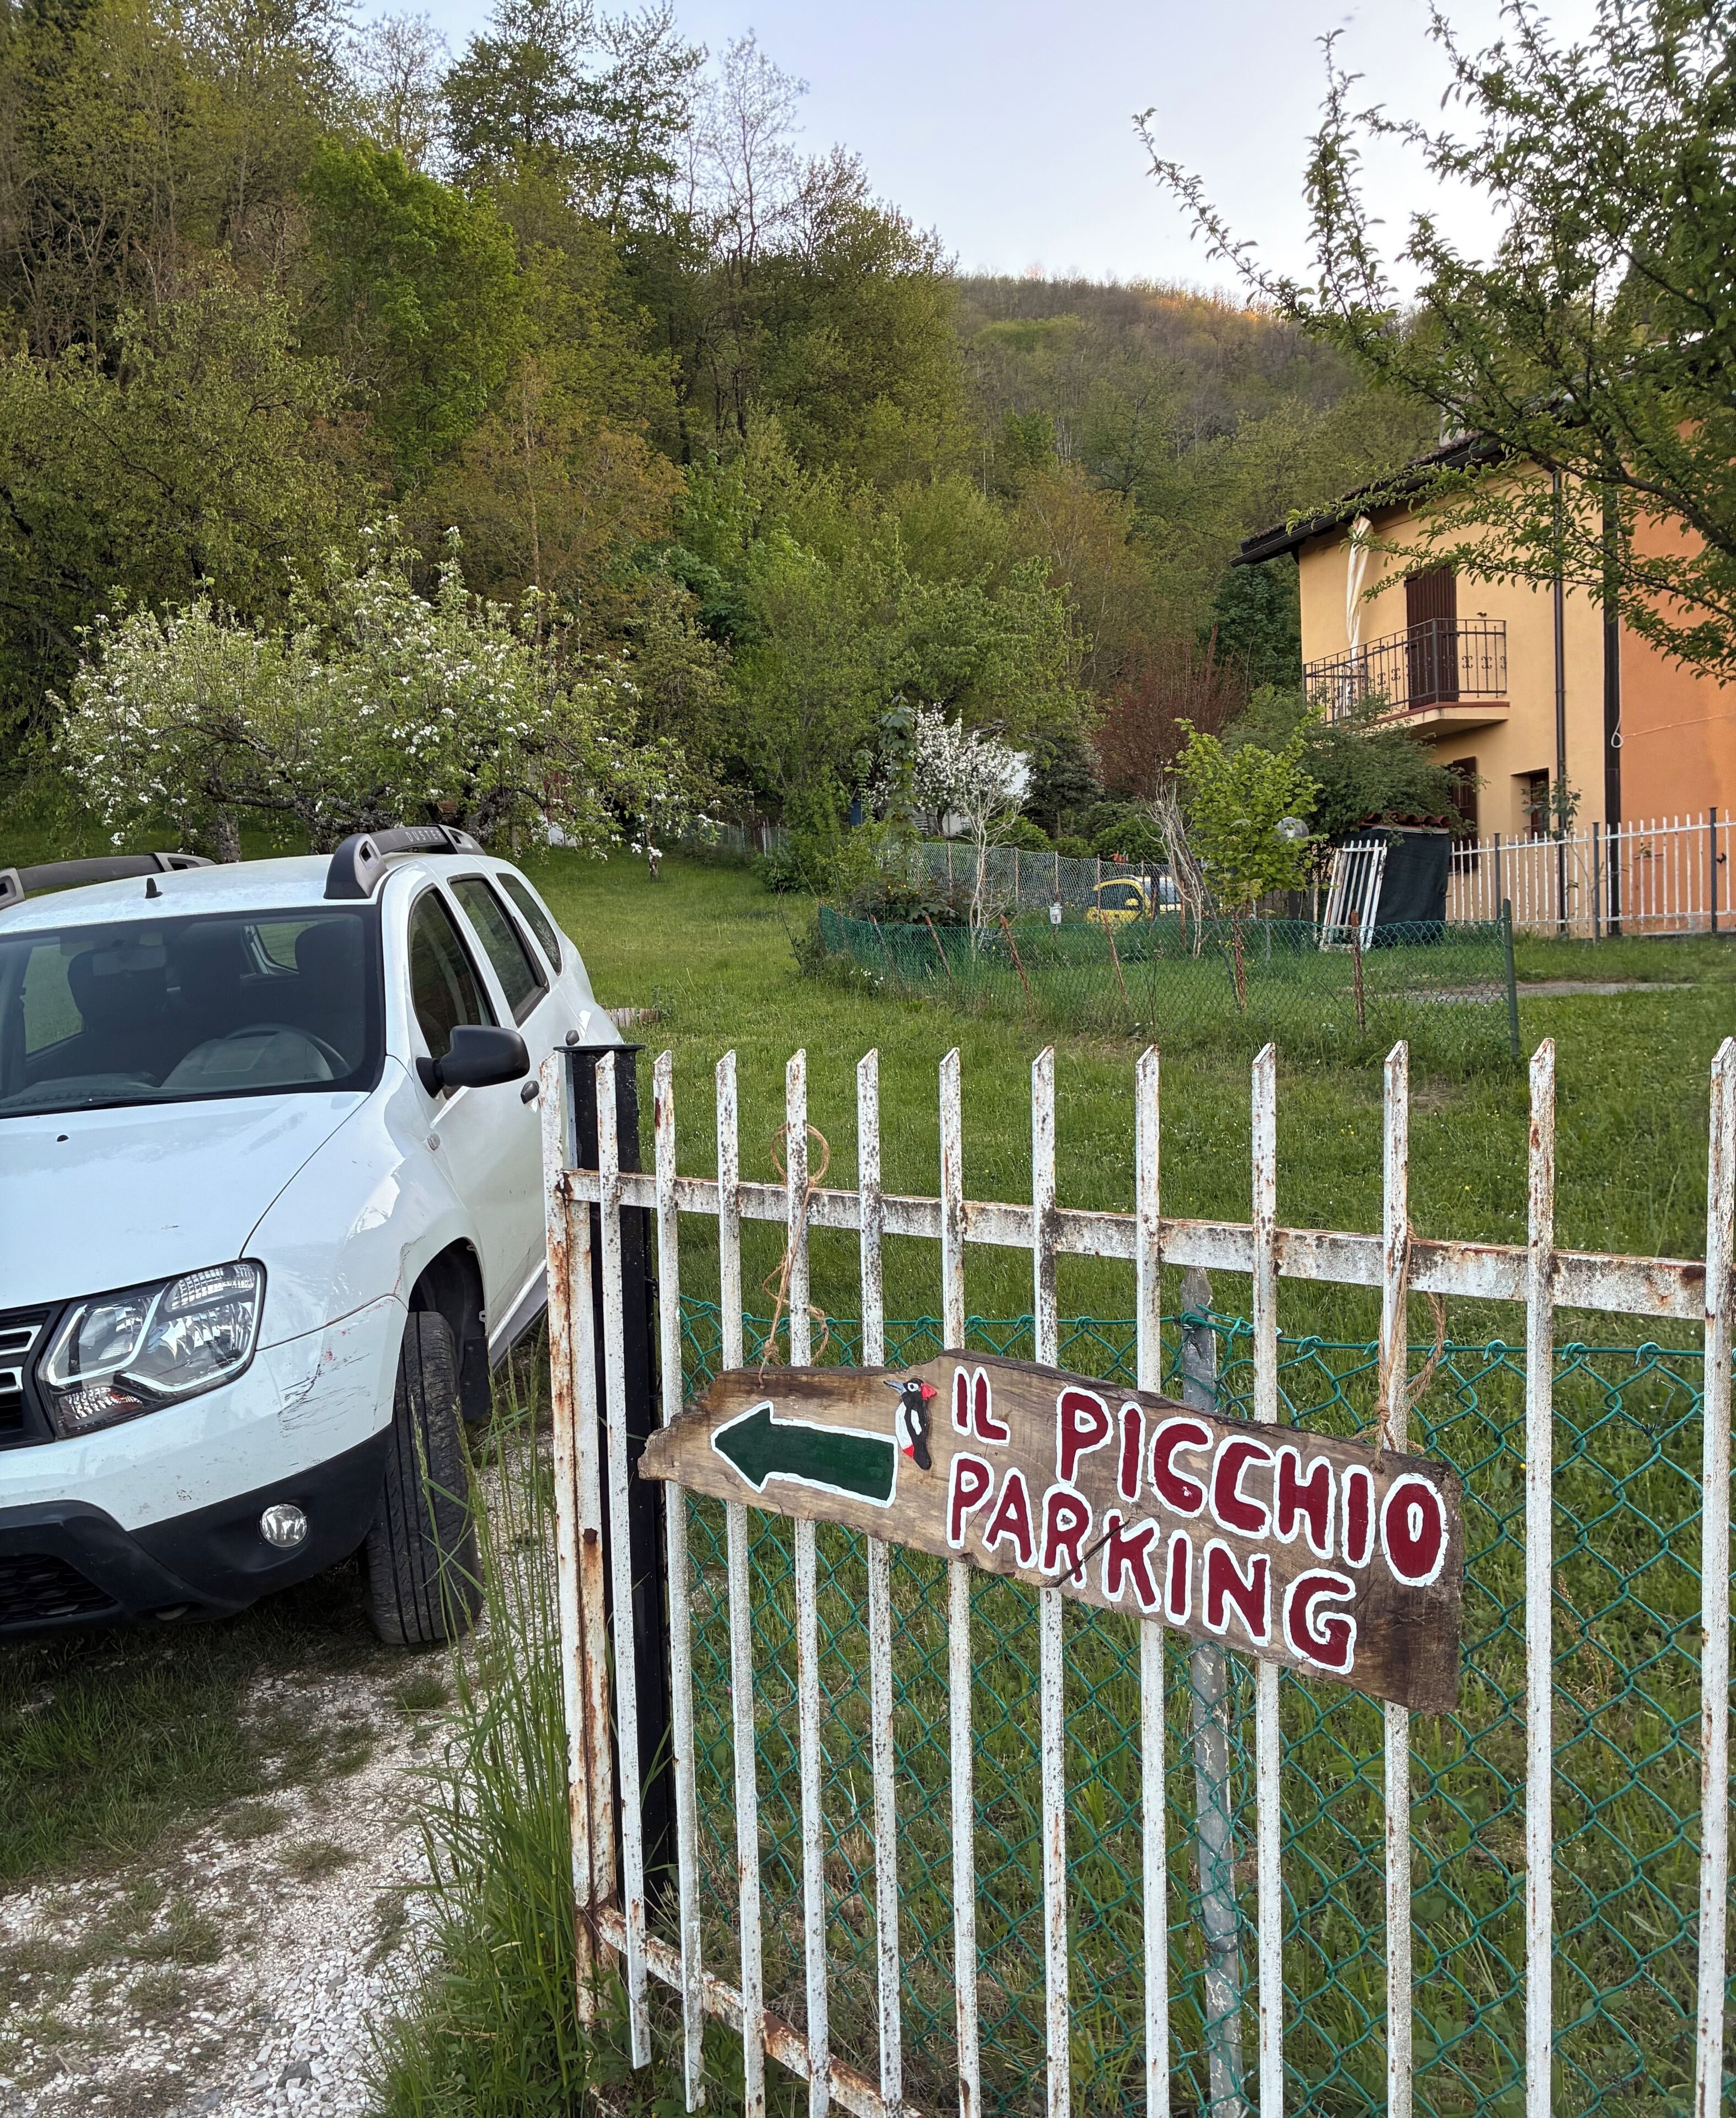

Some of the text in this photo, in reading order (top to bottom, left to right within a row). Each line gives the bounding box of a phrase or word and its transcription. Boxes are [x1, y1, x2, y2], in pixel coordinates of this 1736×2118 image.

[405, 830, 444, 842] DUSTER
[947, 1451, 1356, 1674] PARKING
[951, 1365, 1447, 1586] IL PICCHIO
